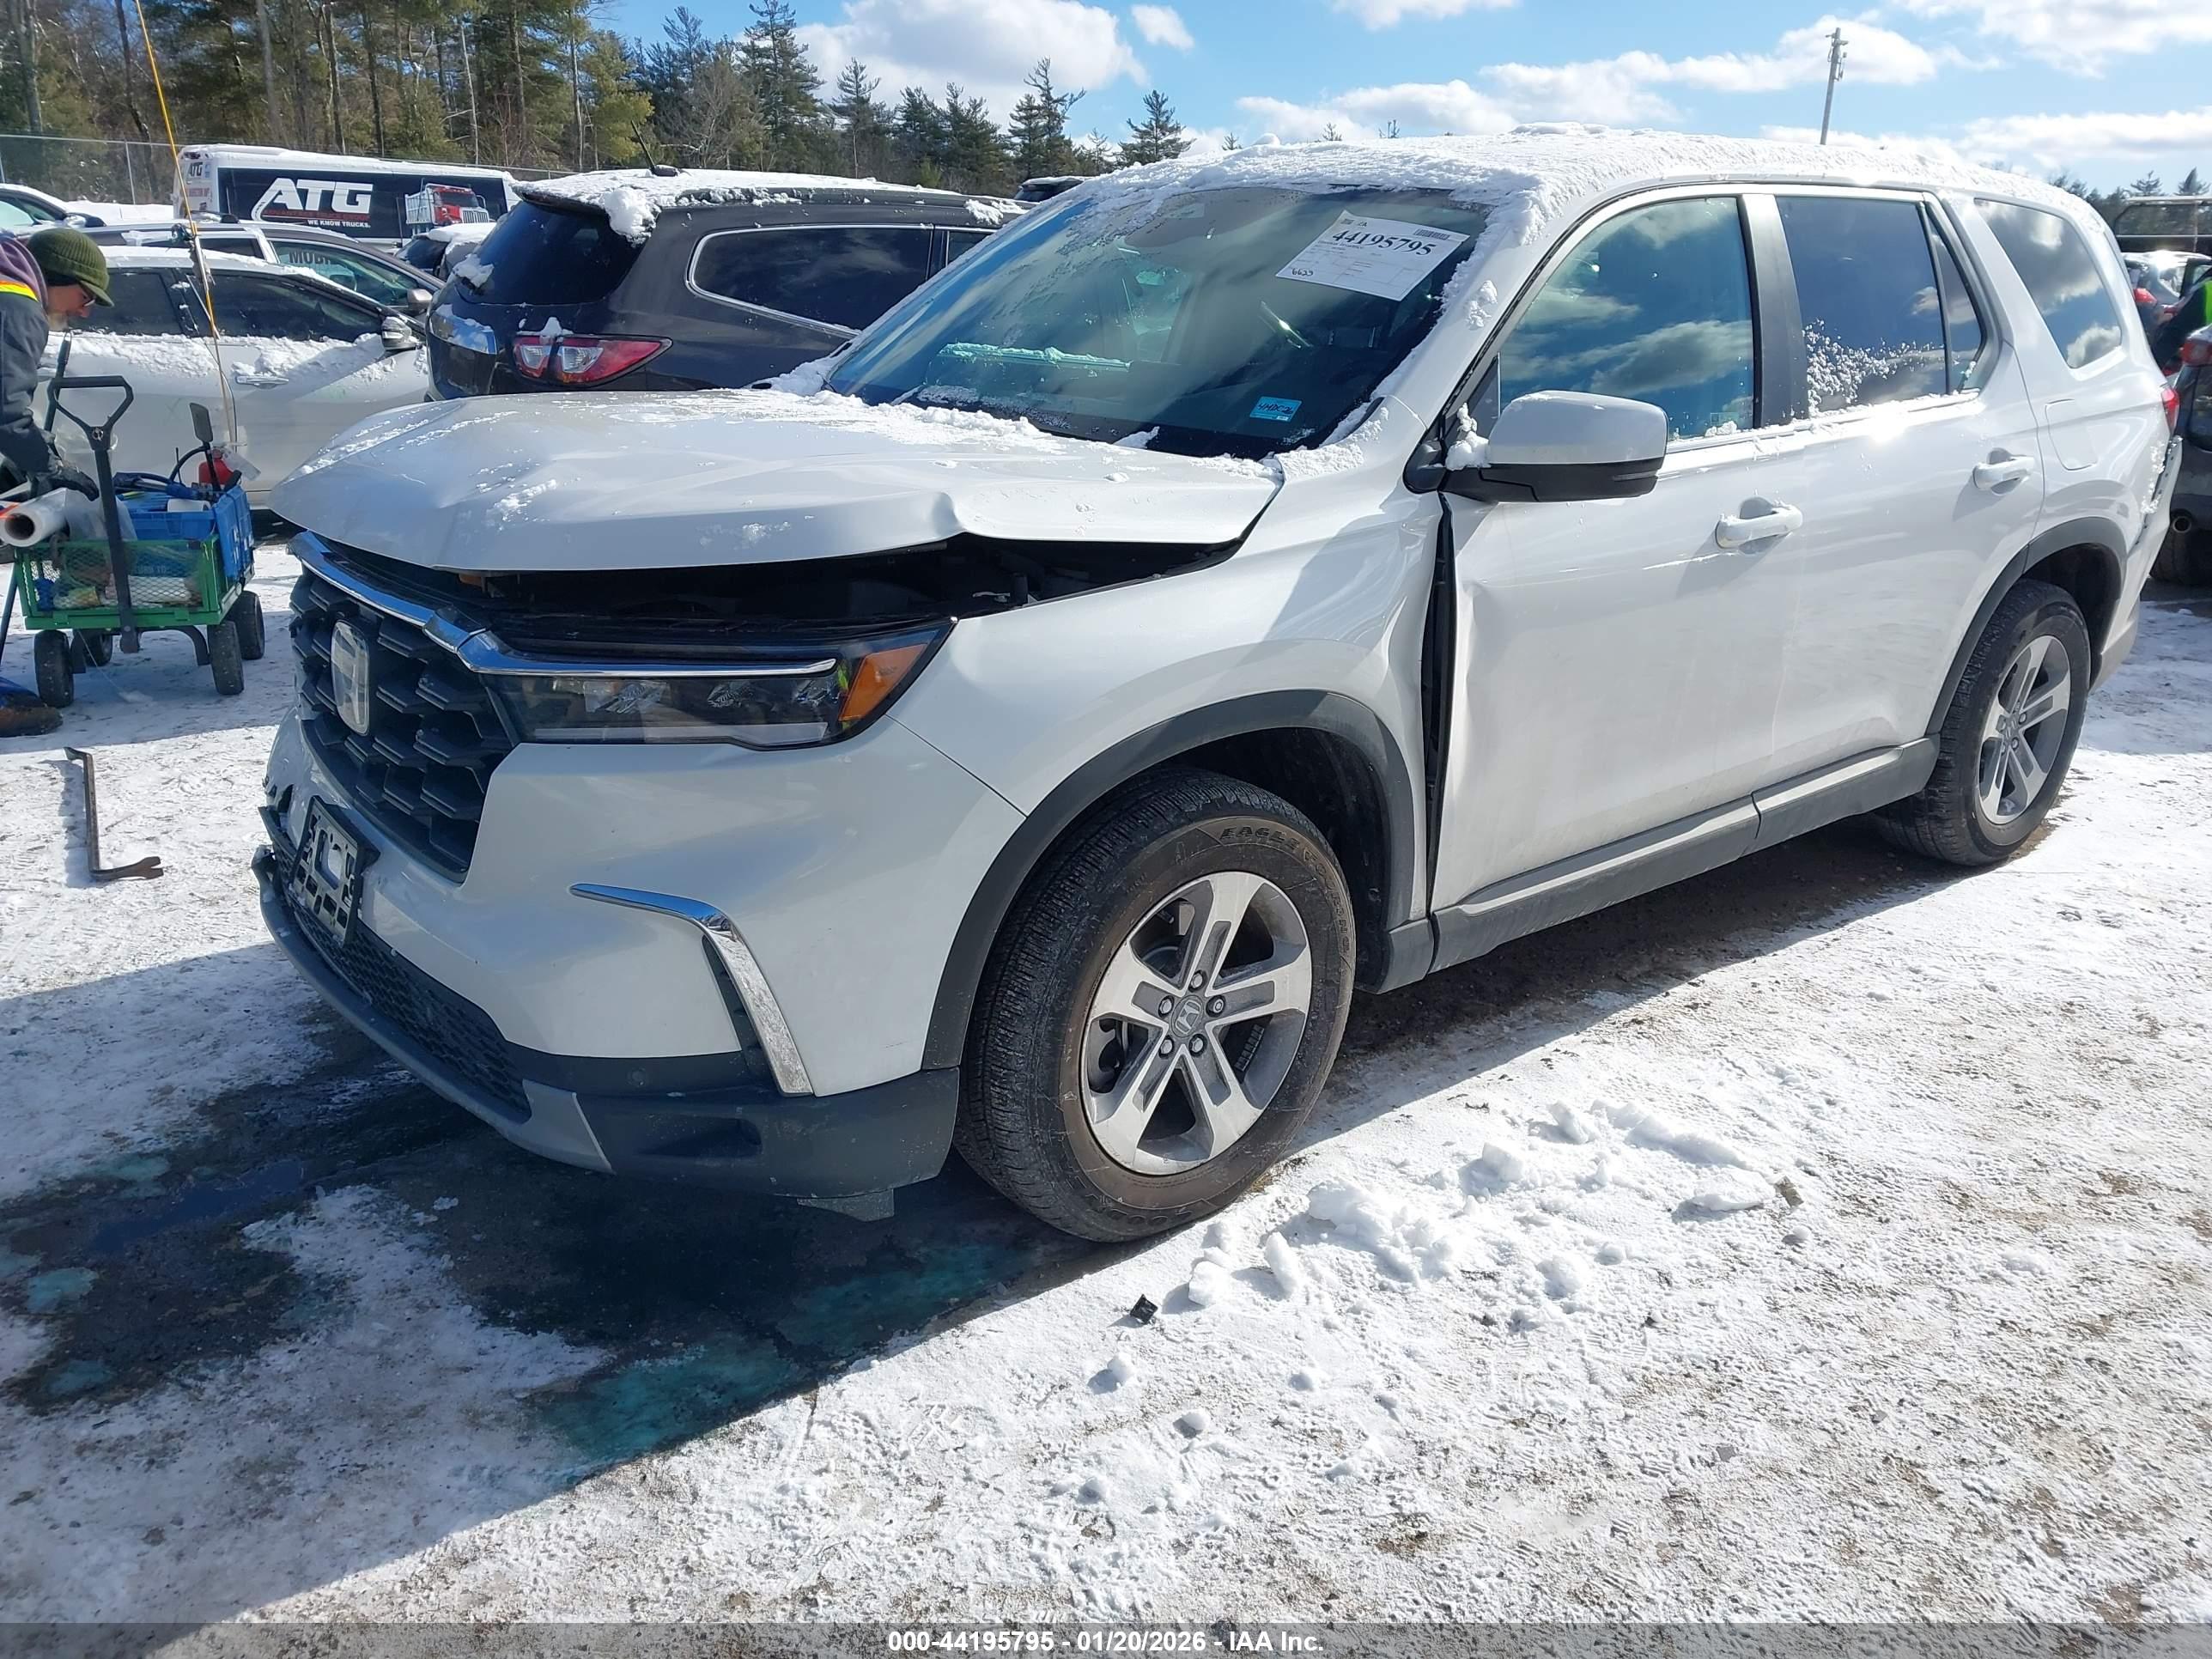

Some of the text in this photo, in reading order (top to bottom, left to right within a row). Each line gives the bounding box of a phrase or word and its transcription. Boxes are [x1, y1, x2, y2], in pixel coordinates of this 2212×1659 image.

[251, 177, 374, 221] ATG
[1333, 230, 1436, 255] 44195795
[1220, 826, 1300, 850] EAGLE
